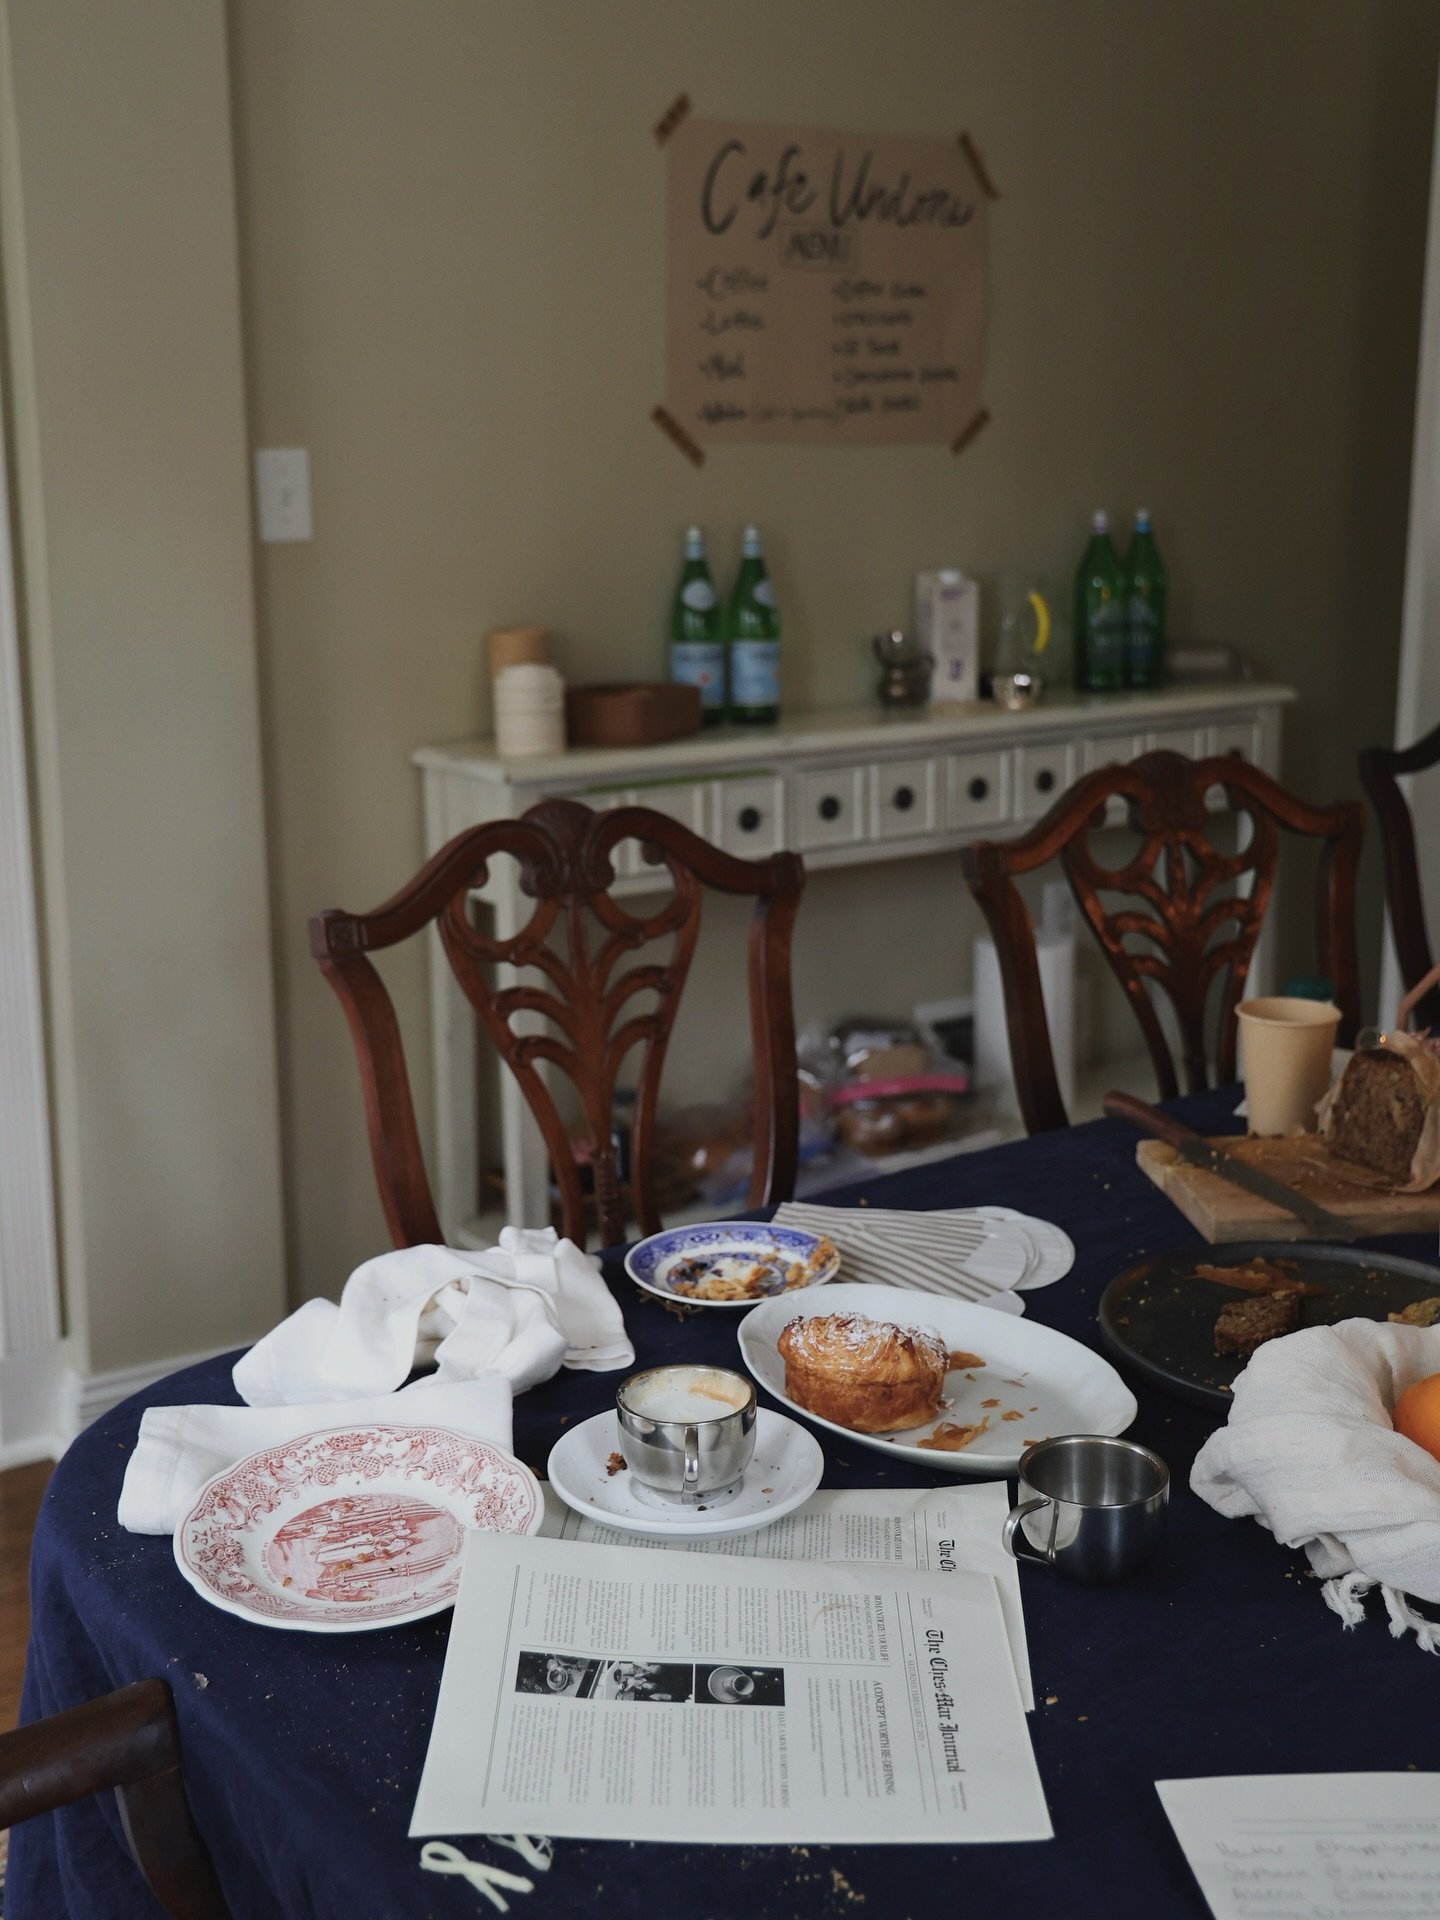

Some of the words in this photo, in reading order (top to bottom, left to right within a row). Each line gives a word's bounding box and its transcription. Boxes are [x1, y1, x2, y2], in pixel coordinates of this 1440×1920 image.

[702, 138, 817, 240] Cafe
[936, 1540, 955, 1558] The
[874, 1594, 886, 1633] ROMANTICIZE
[878, 1634, 888, 1649] YOUR
[880, 1650, 889, 1662] LIFE
[874, 1687, 887, 1719] CONCEPT
[924, 1629, 945, 1654] The
[938, 1722, 966, 1773] Journal
[878, 1721, 890, 1749] WORTH
[881, 1750, 896, 1796] RE-DEFINING
